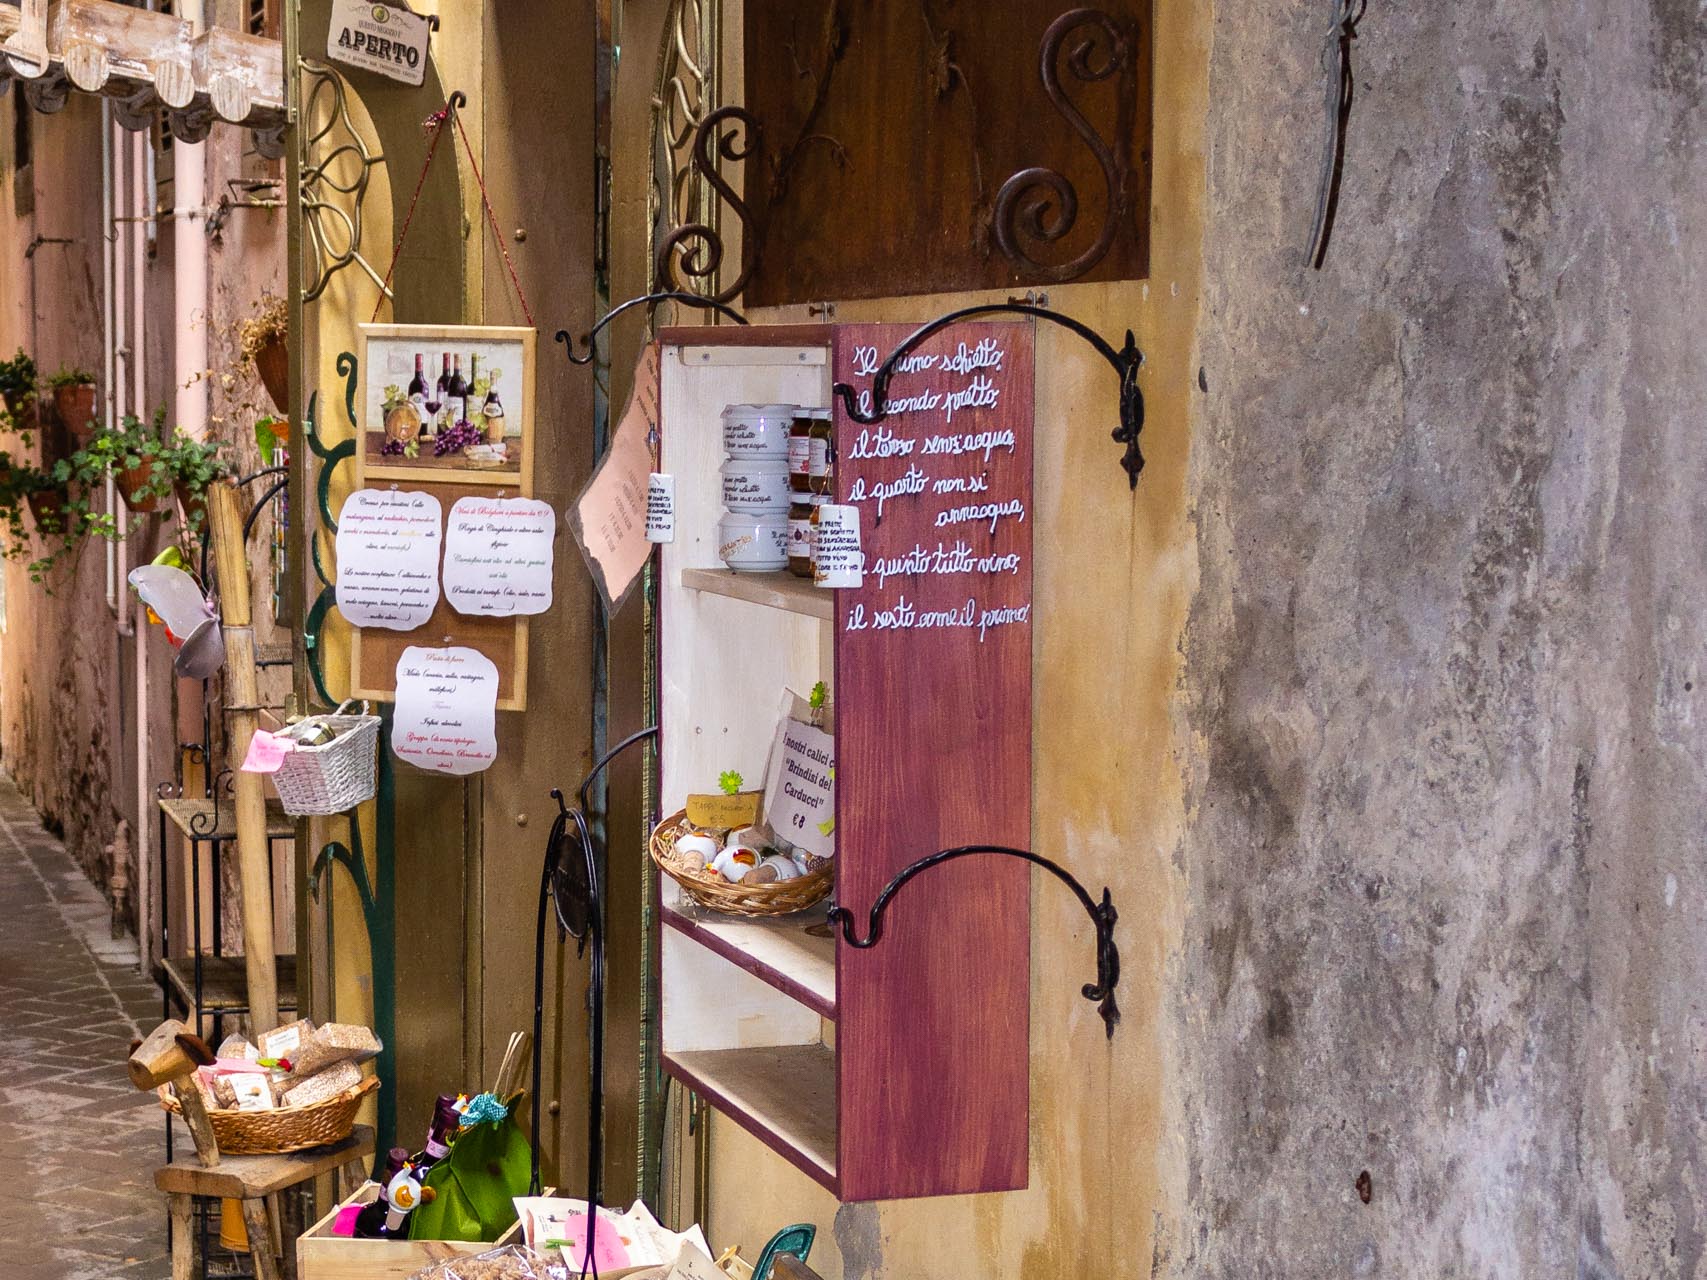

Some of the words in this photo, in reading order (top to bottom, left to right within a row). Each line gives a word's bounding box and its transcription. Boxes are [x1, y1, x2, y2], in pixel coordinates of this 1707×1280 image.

[338, 27, 419, 68] APERTO
[853, 345, 878, 376] Il
[880, 389, 942, 415] econdo
[848, 429, 872, 459] il
[871, 427, 915, 457] terzo
[848, 478, 867, 501] il
[869, 463, 929, 517] quarto
[932, 475, 966, 494] non
[968, 473, 988, 493] si
[934, 499, 1025, 533] annacqua,
[872, 544, 931, 589] quinto
[931, 541, 978, 574] tutto
[977, 553, 1020, 575] vino,
[846, 604, 867, 632] il
[872, 596, 916, 630] sesto
[915, 608, 957, 628] come
[959, 599, 976, 626] il
[786, 737, 808, 755] nostri
[806, 748, 830, 767] calici
[819, 775, 833, 792] del
